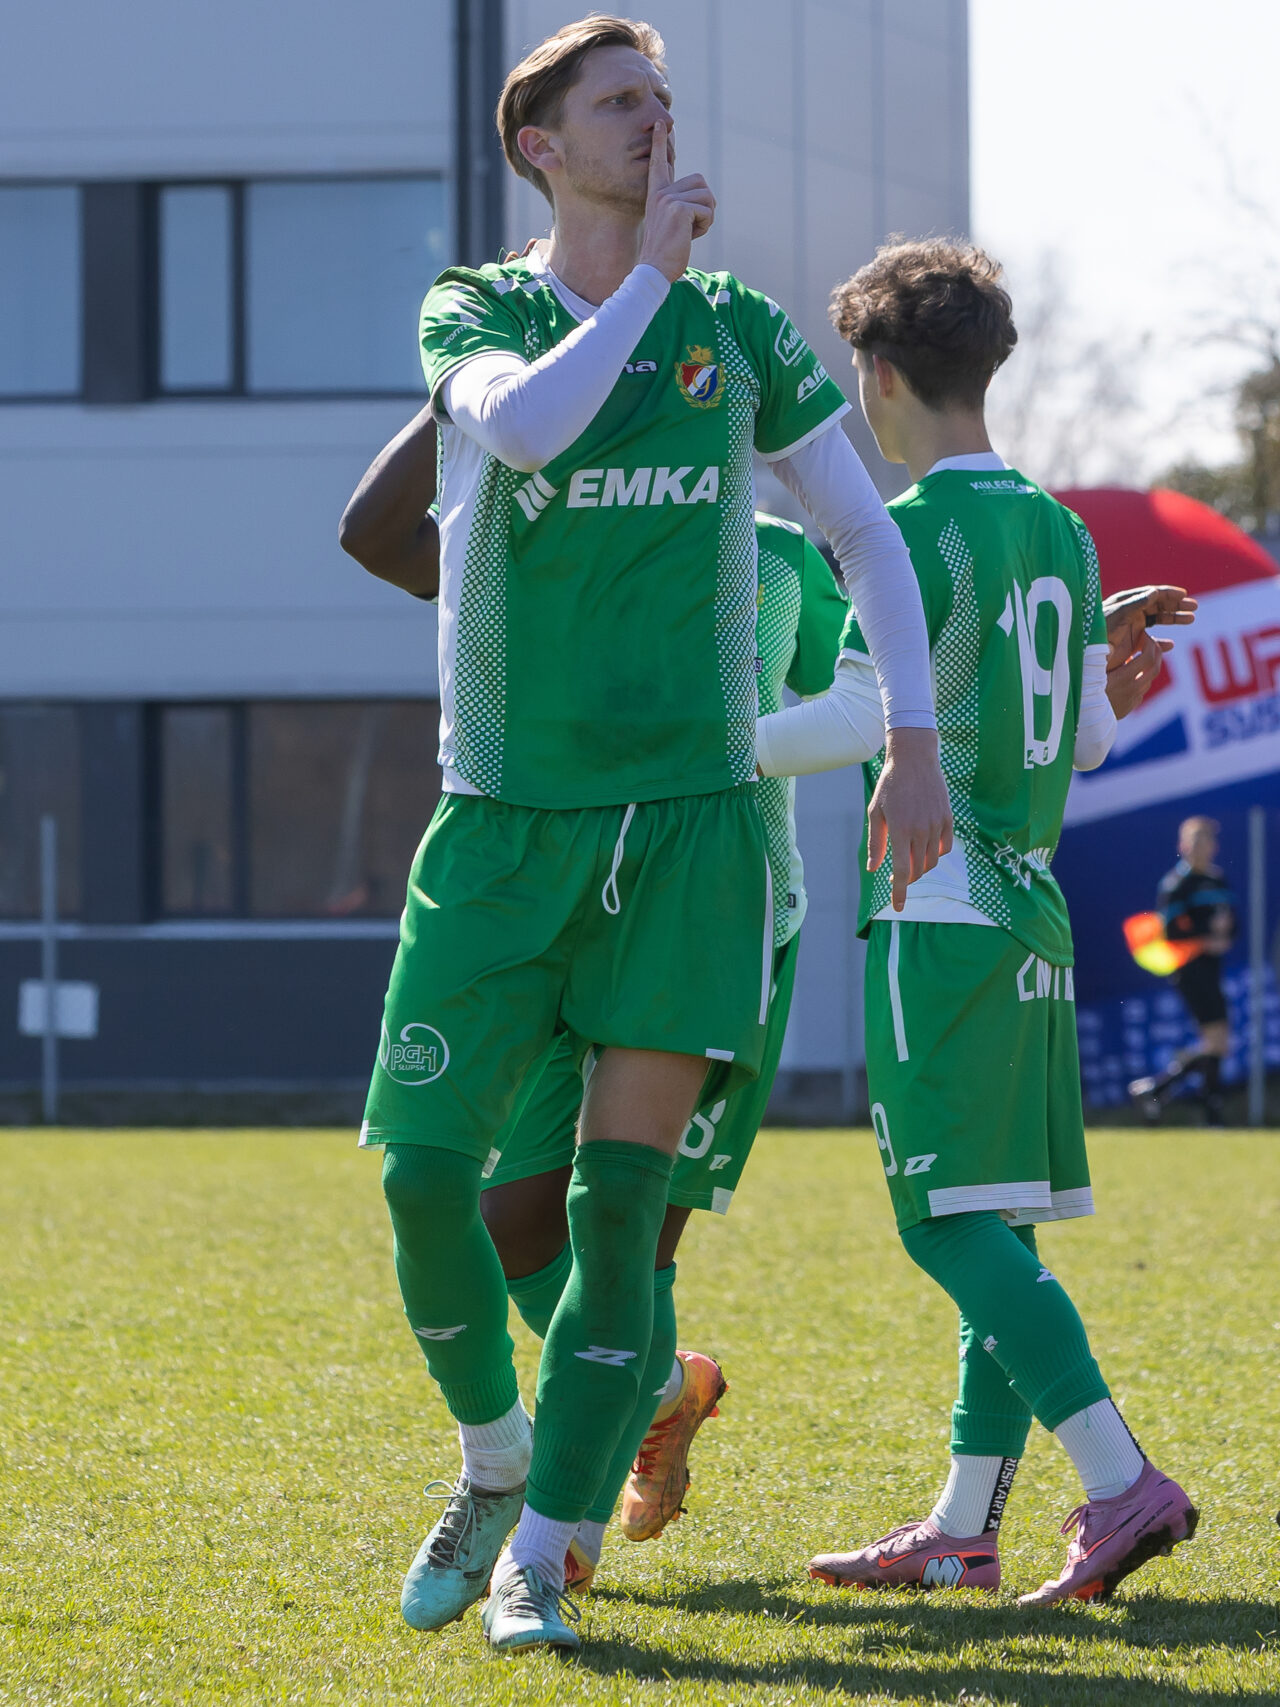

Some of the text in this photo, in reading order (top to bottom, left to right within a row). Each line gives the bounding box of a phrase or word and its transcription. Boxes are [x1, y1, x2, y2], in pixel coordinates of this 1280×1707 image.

[566, 466, 719, 508] EMKA
[998, 575, 1073, 770] 19
[391, 1044, 437, 1072] PGH
